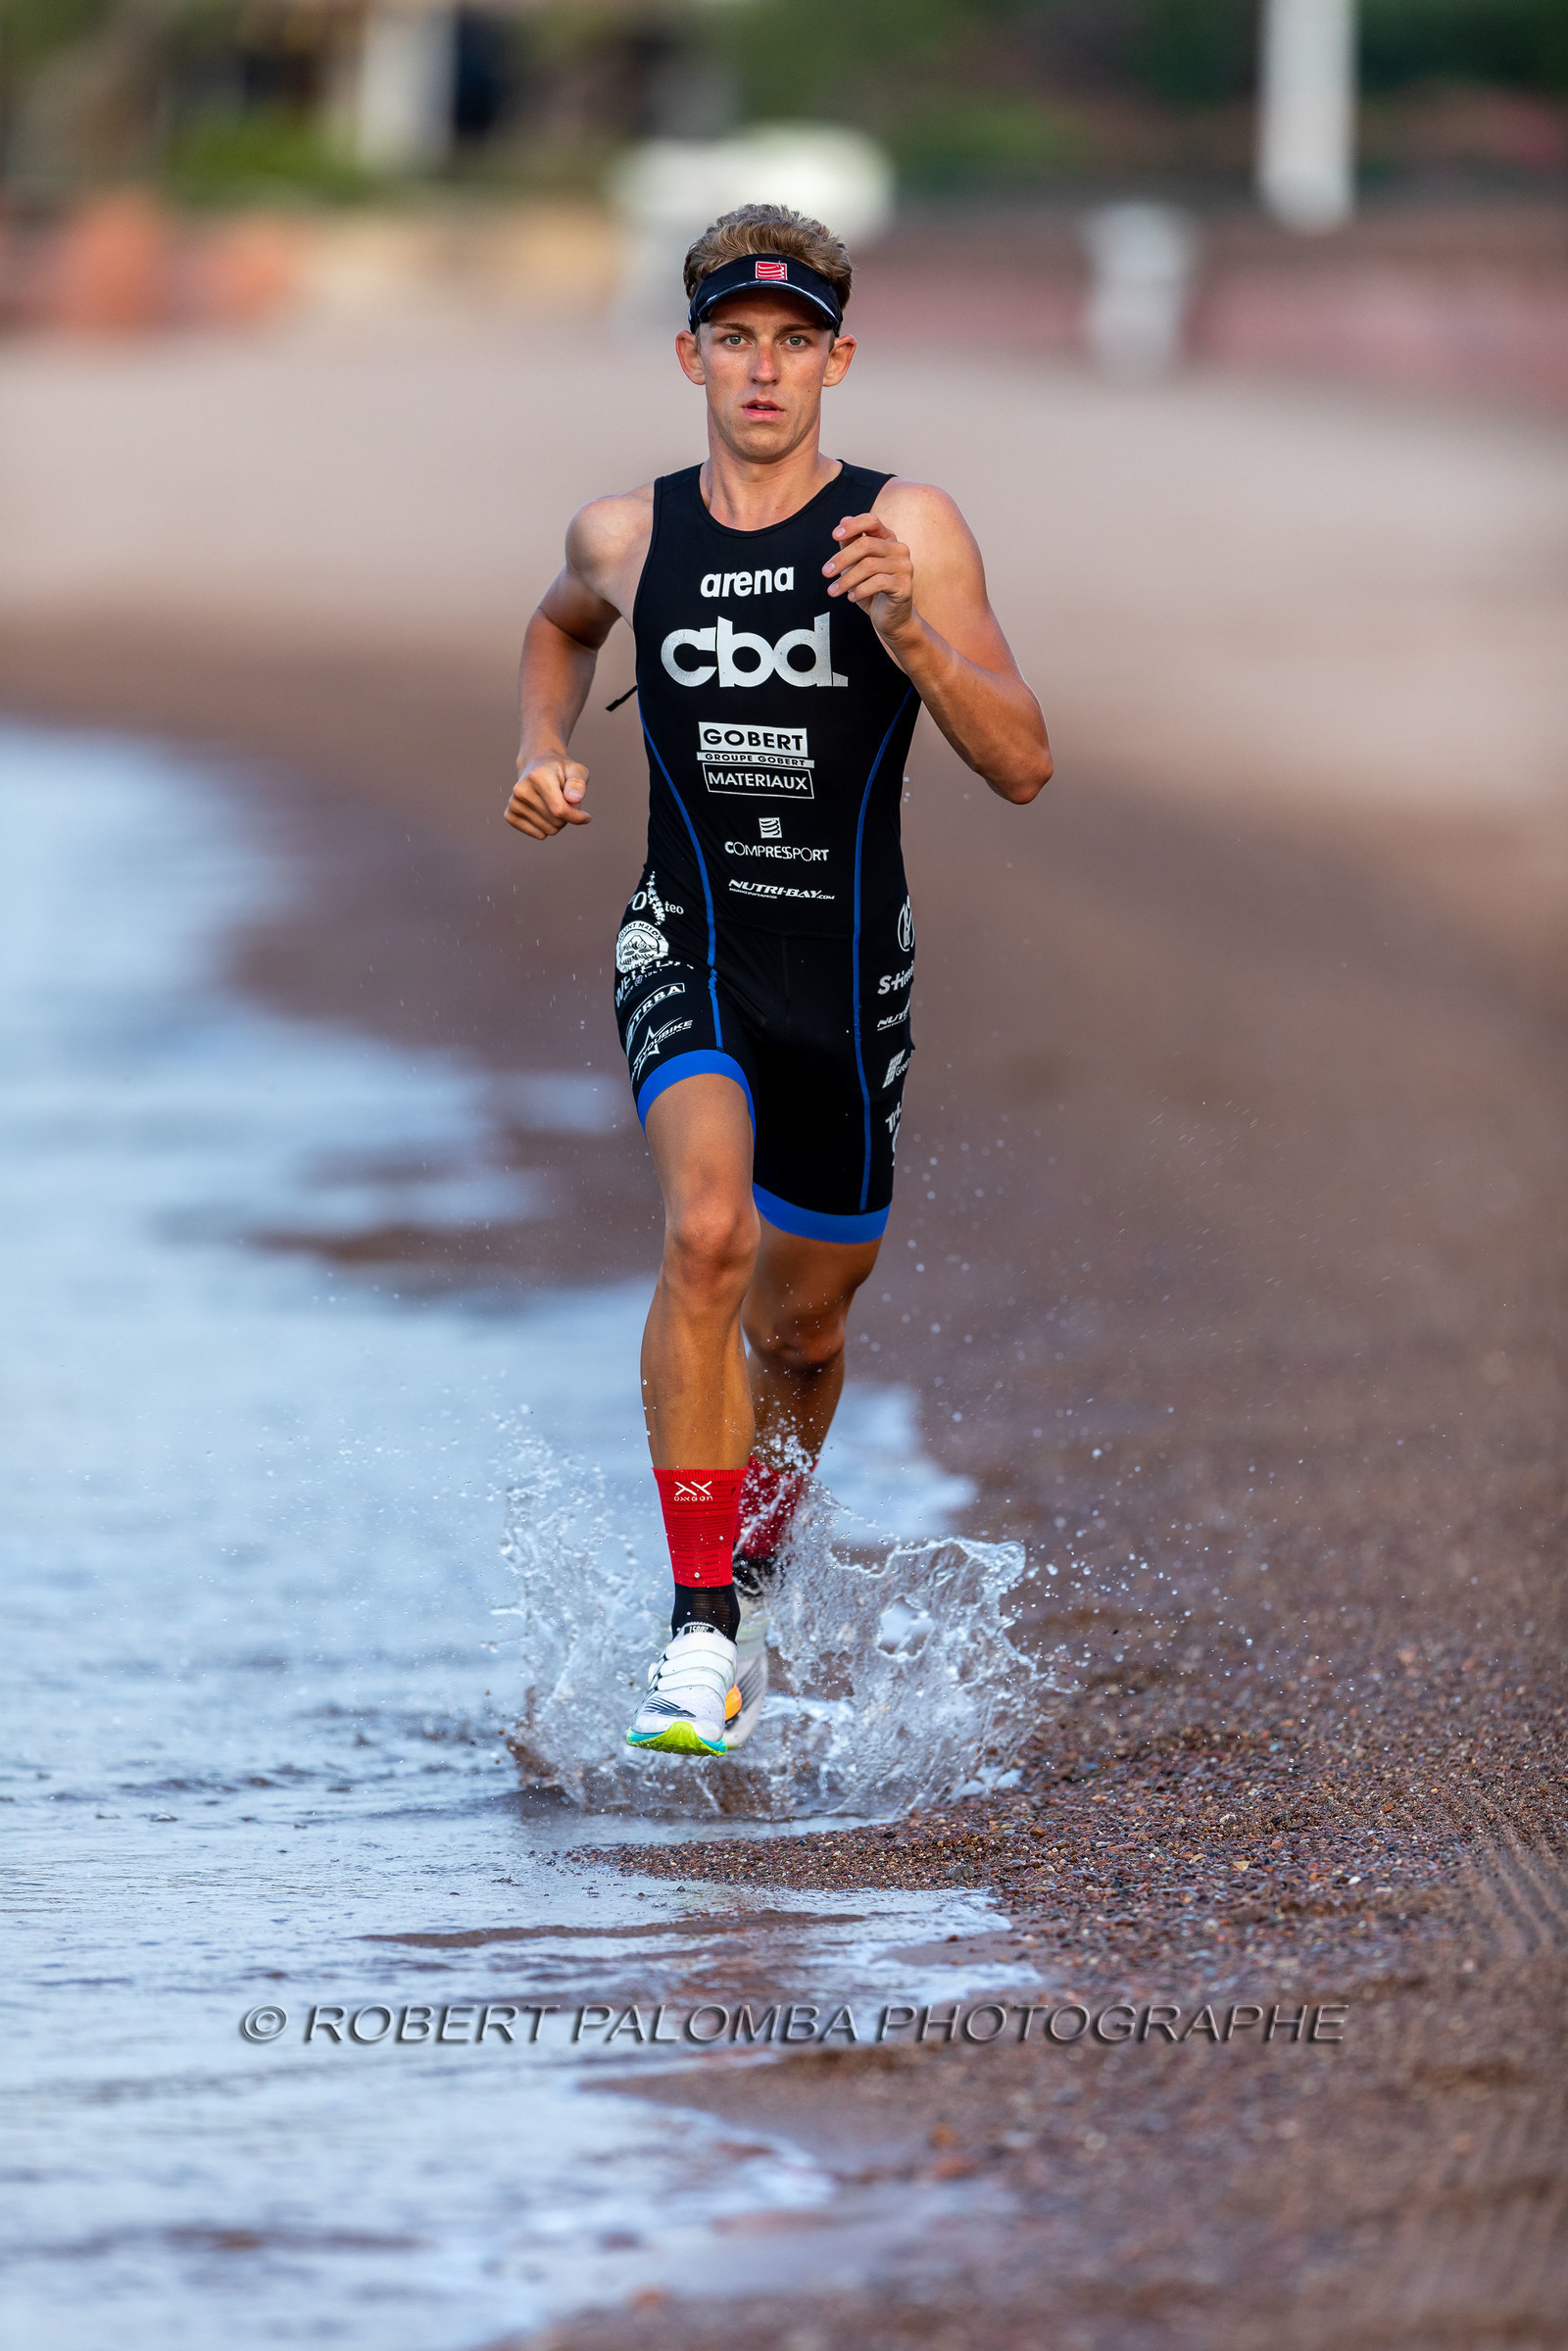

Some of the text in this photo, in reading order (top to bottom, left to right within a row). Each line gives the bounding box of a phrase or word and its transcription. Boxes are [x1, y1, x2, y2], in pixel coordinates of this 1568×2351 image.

[700, 566, 795, 598] arena
[702, 727, 805, 753] GOBERT
[705, 752, 806, 766] GROUPE GOBERT
[708, 771, 808, 791] MATERIAUX
